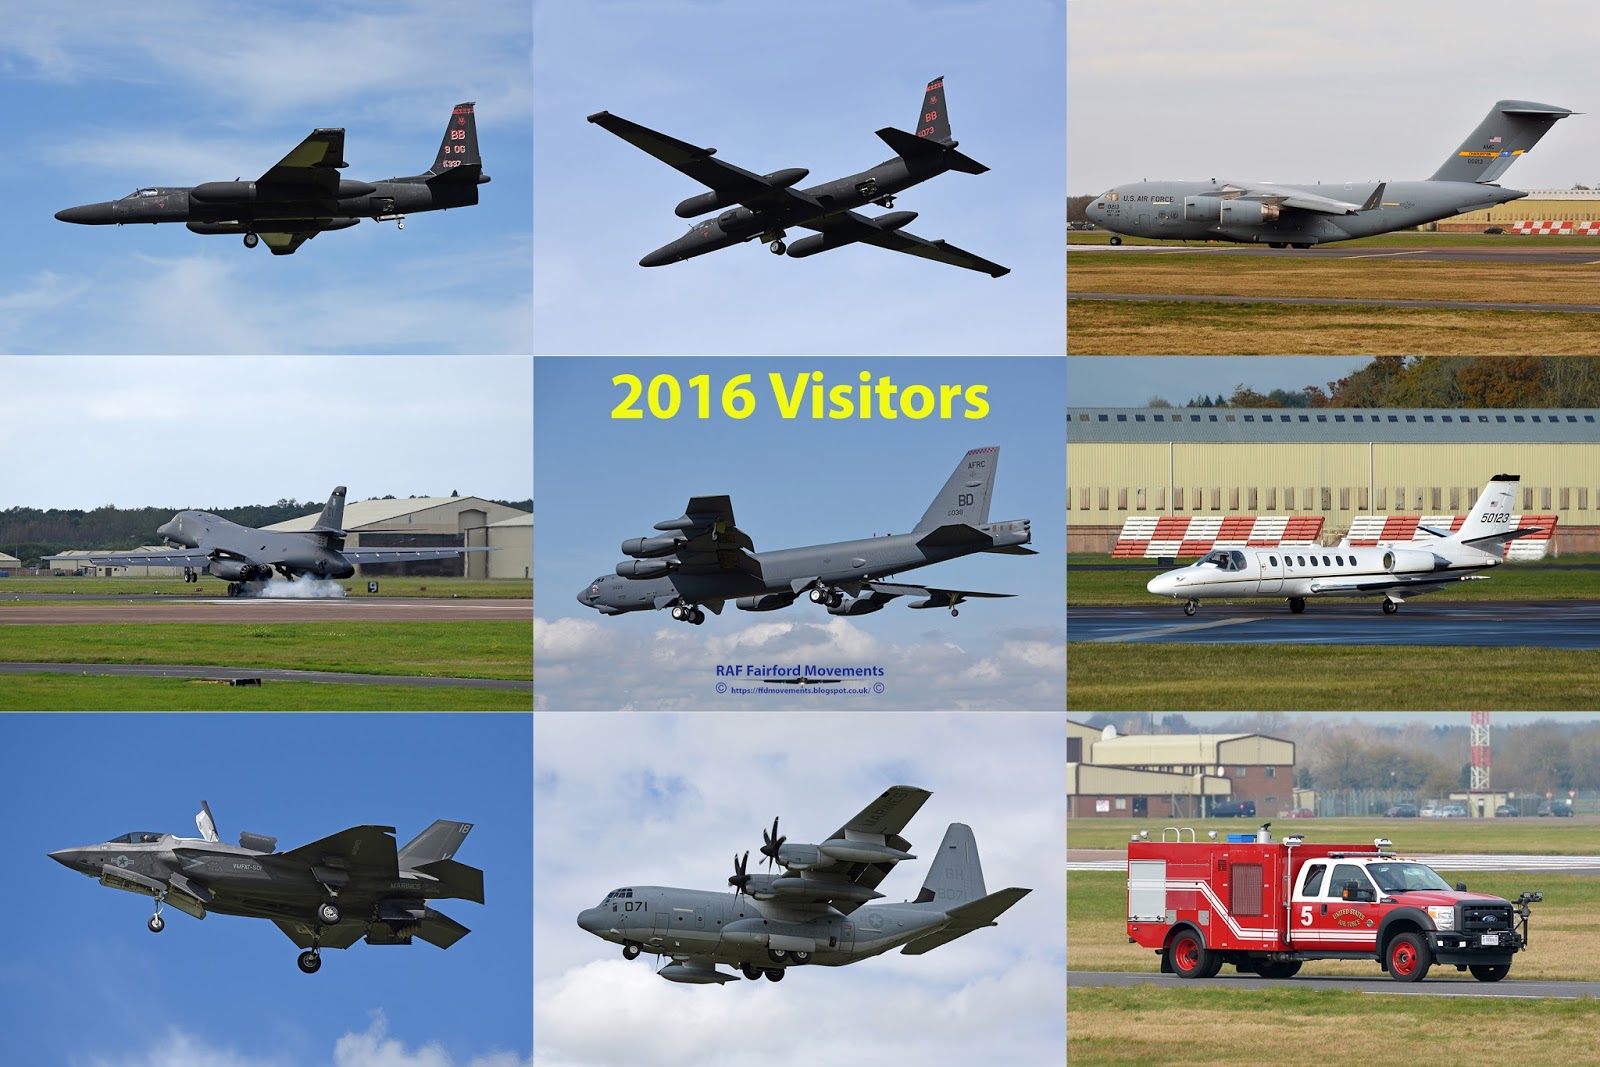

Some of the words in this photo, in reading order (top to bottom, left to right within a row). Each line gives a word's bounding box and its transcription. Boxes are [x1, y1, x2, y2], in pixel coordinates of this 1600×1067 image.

[926, 111, 938, 122] BB
[451, 130, 466, 140] BB
[1150, 195, 1174, 203] FORCE
[968, 461, 986, 470] AFRC
[958, 493, 974, 507] BD
[1481, 513, 1510, 523] 50123
[369, 582, 378, 593] 9
[861, 792, 908, 827] MARINES
[458, 824, 470, 834] 18
[945, 868, 964, 880] BH
[624, 901, 648, 912] 071
[1300, 905, 1314, 927] 5
[1332, 908, 1350, 920] UNITED
[1349, 908, 1366, 921] STATES
[1338, 919, 1347, 927] AIR
[1347, 919, 1361, 928] FORCE
